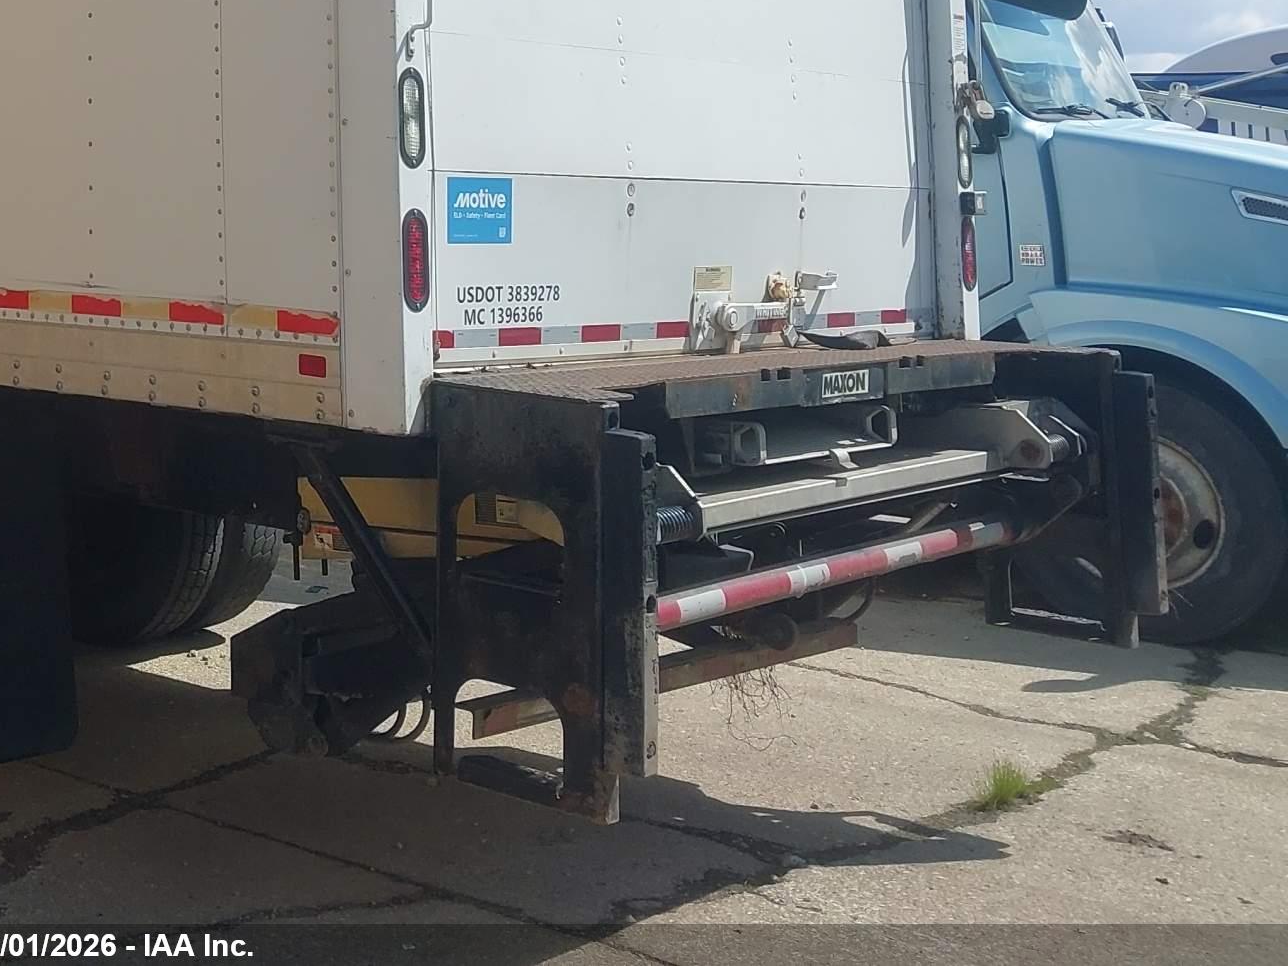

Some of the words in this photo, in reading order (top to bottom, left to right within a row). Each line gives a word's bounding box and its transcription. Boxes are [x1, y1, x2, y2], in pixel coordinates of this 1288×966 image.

[457, 286, 504, 303] USDOT
[507, 285, 560, 302] 3839278
[464, 308, 486, 325] MC
[490, 306, 543, 324] 1396366
[823, 372, 866, 395] MAXON
